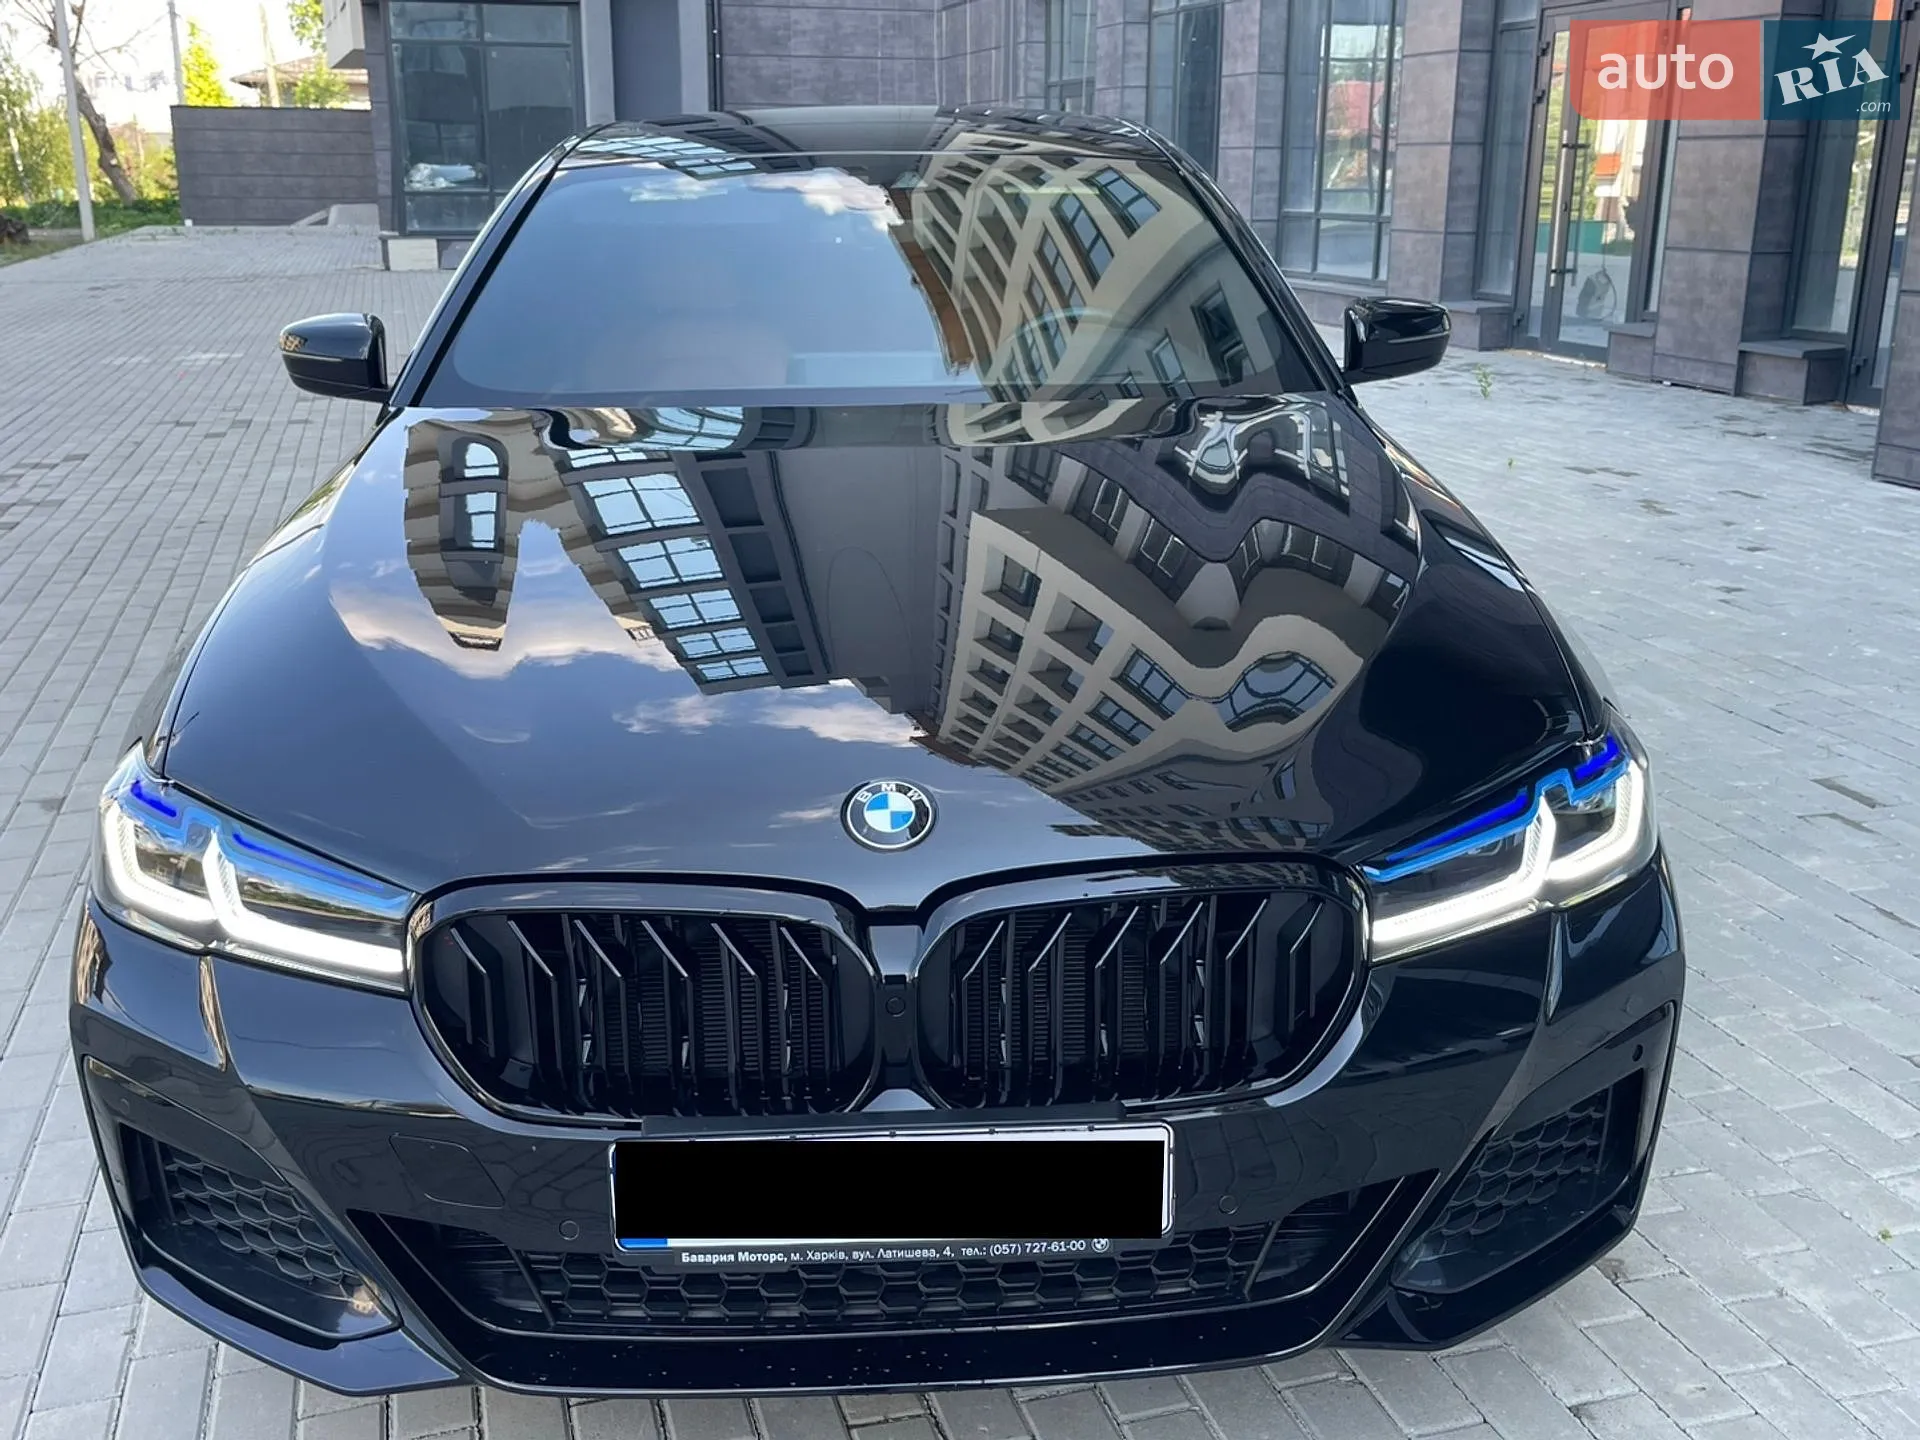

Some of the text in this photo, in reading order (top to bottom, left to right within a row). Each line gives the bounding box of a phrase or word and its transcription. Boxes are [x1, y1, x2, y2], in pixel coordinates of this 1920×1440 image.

[856, 783, 923, 803] BMW
[681, 1240, 1087, 1264] Бавария Моторс, м. Харків, вул. Латишева, 4, тел.: (057) 727-61-00
